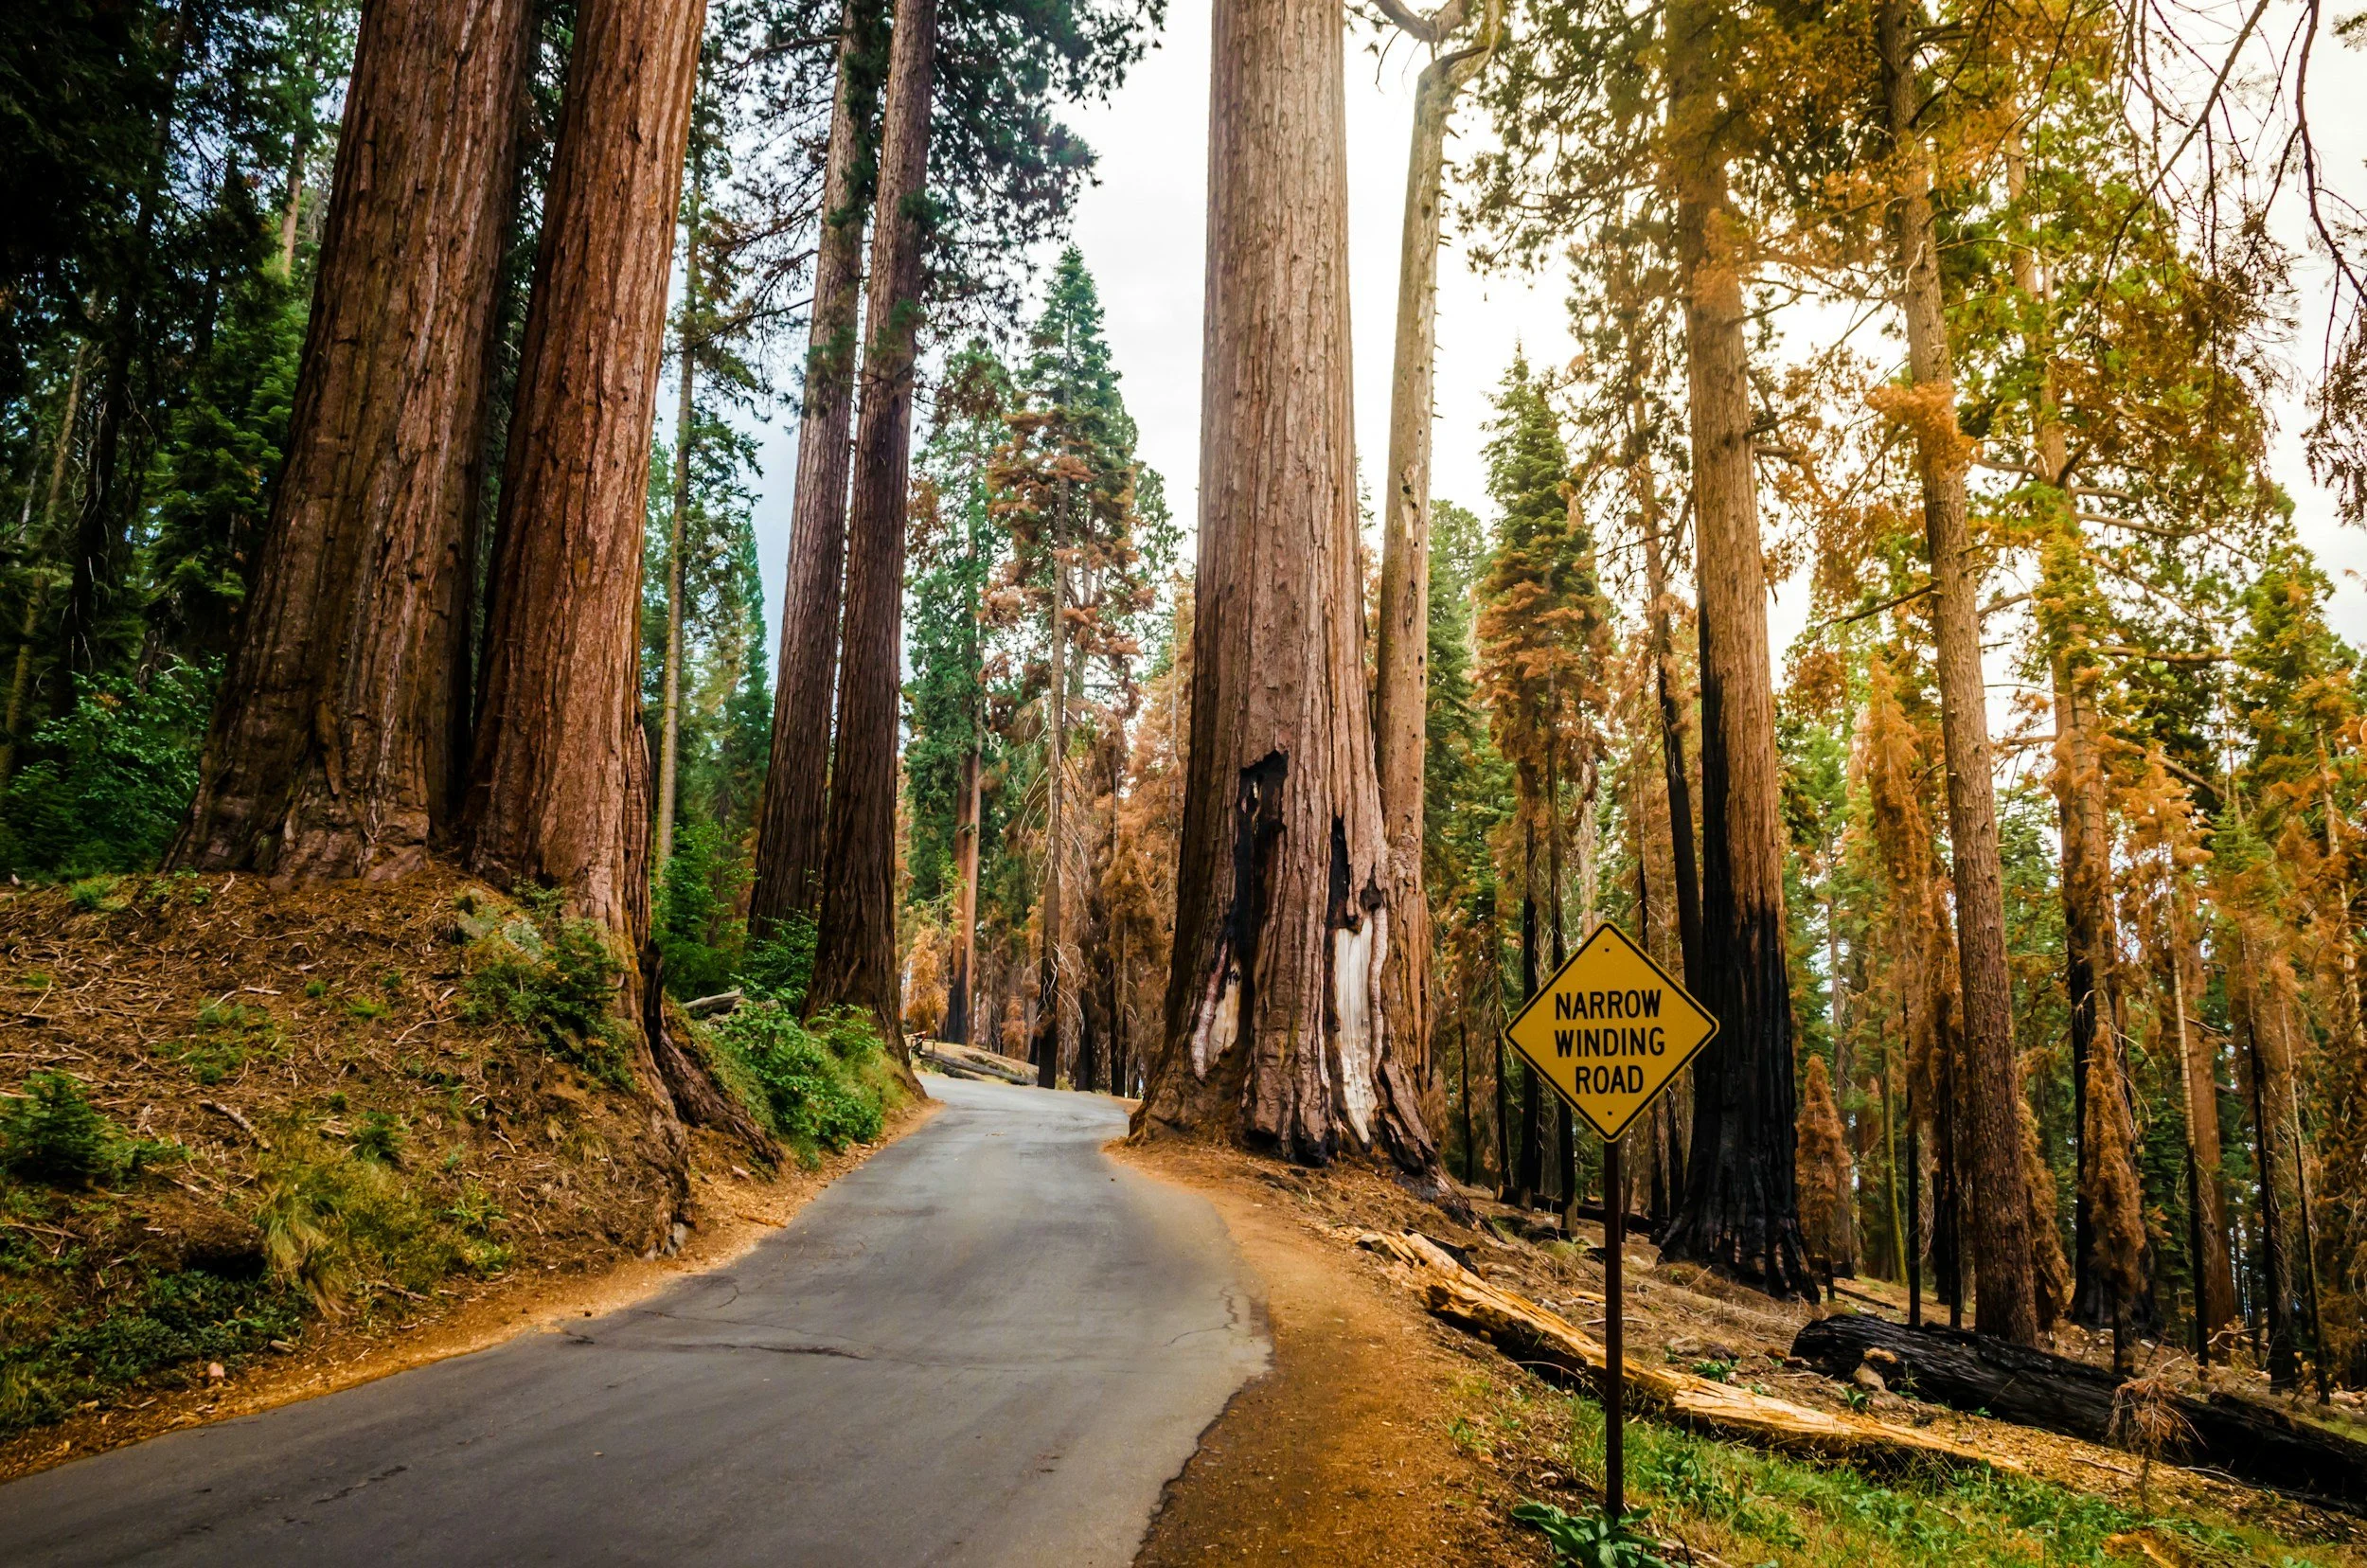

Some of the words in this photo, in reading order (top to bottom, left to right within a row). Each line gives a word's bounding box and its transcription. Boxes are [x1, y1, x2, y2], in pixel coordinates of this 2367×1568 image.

[1555, 989, 1662, 1021] NARROW
[1554, 1026, 1665, 1058] WINDING
[1575, 1064, 1645, 1095] ROAD
